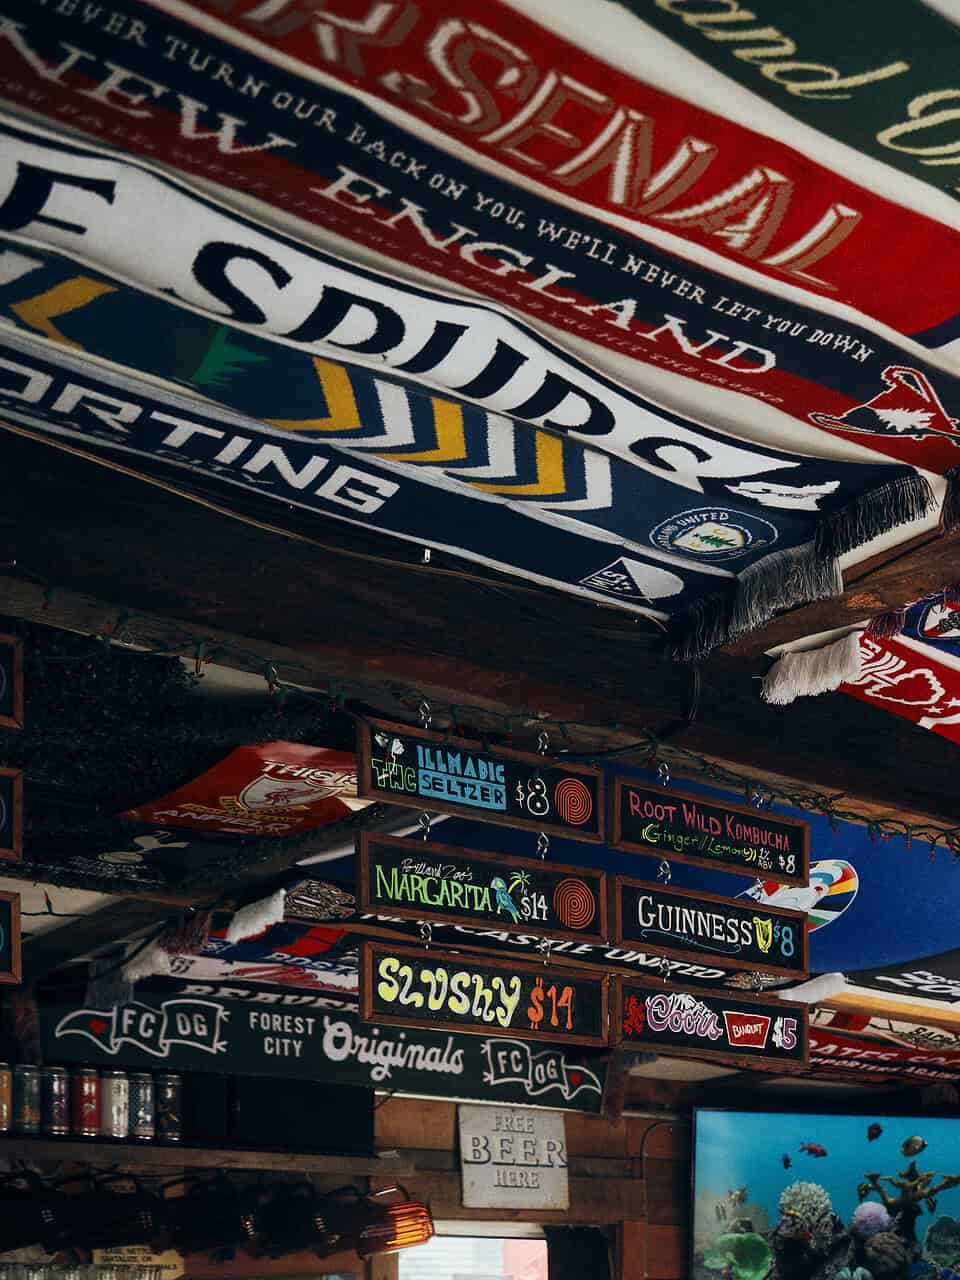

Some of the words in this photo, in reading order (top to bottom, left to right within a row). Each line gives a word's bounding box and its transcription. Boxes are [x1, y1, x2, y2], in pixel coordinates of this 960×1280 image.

[235, 0, 866, 293] RSENAL
[0, 15, 297, 153] NEW
[309, 163, 777, 375] ENGLAND
[163, 35, 270, 98] TURN
[271, 90, 338, 133] OUR
[345, 122, 428, 181] BACK
[429, 173, 469, 201] ON
[536, 218, 617, 265] WE'LL
[621, 253, 706, 305] NEVER
[711, 297, 760, 321] LET
[762, 314, 805, 337] YOU
[805, 329, 876, 364] DOWN
[420, 773, 505, 805] SELTZER
[515, 777, 550, 816] $8
[629, 790, 677, 821] ROOT
[682, 802, 721, 836] WILD
[725, 814, 790, 852] KOMBUCHA
[778, 853, 797, 874] $8
[375, 864, 493, 912] MARGARITA
[520, 891, 549, 921] $14
[638, 895, 753, 947] GUINNESS
[773, 920, 795, 957] $8
[603, 947, 728, 981] UNITED
[377, 957, 521, 1028] SLUSHY
[527, 975, 576, 1031] $14
[121, 1010, 156, 1039] FC
[249, 1011, 316, 1036] FOREST
[646, 995, 724, 1041] Coors
[772, 1015, 798, 1050] $5
[263, 1034, 303, 1057] CITY
[322, 1013, 465, 1082] Originals
[497, 1047, 525, 1074] FC
[471, 1133, 568, 1168] BEER
